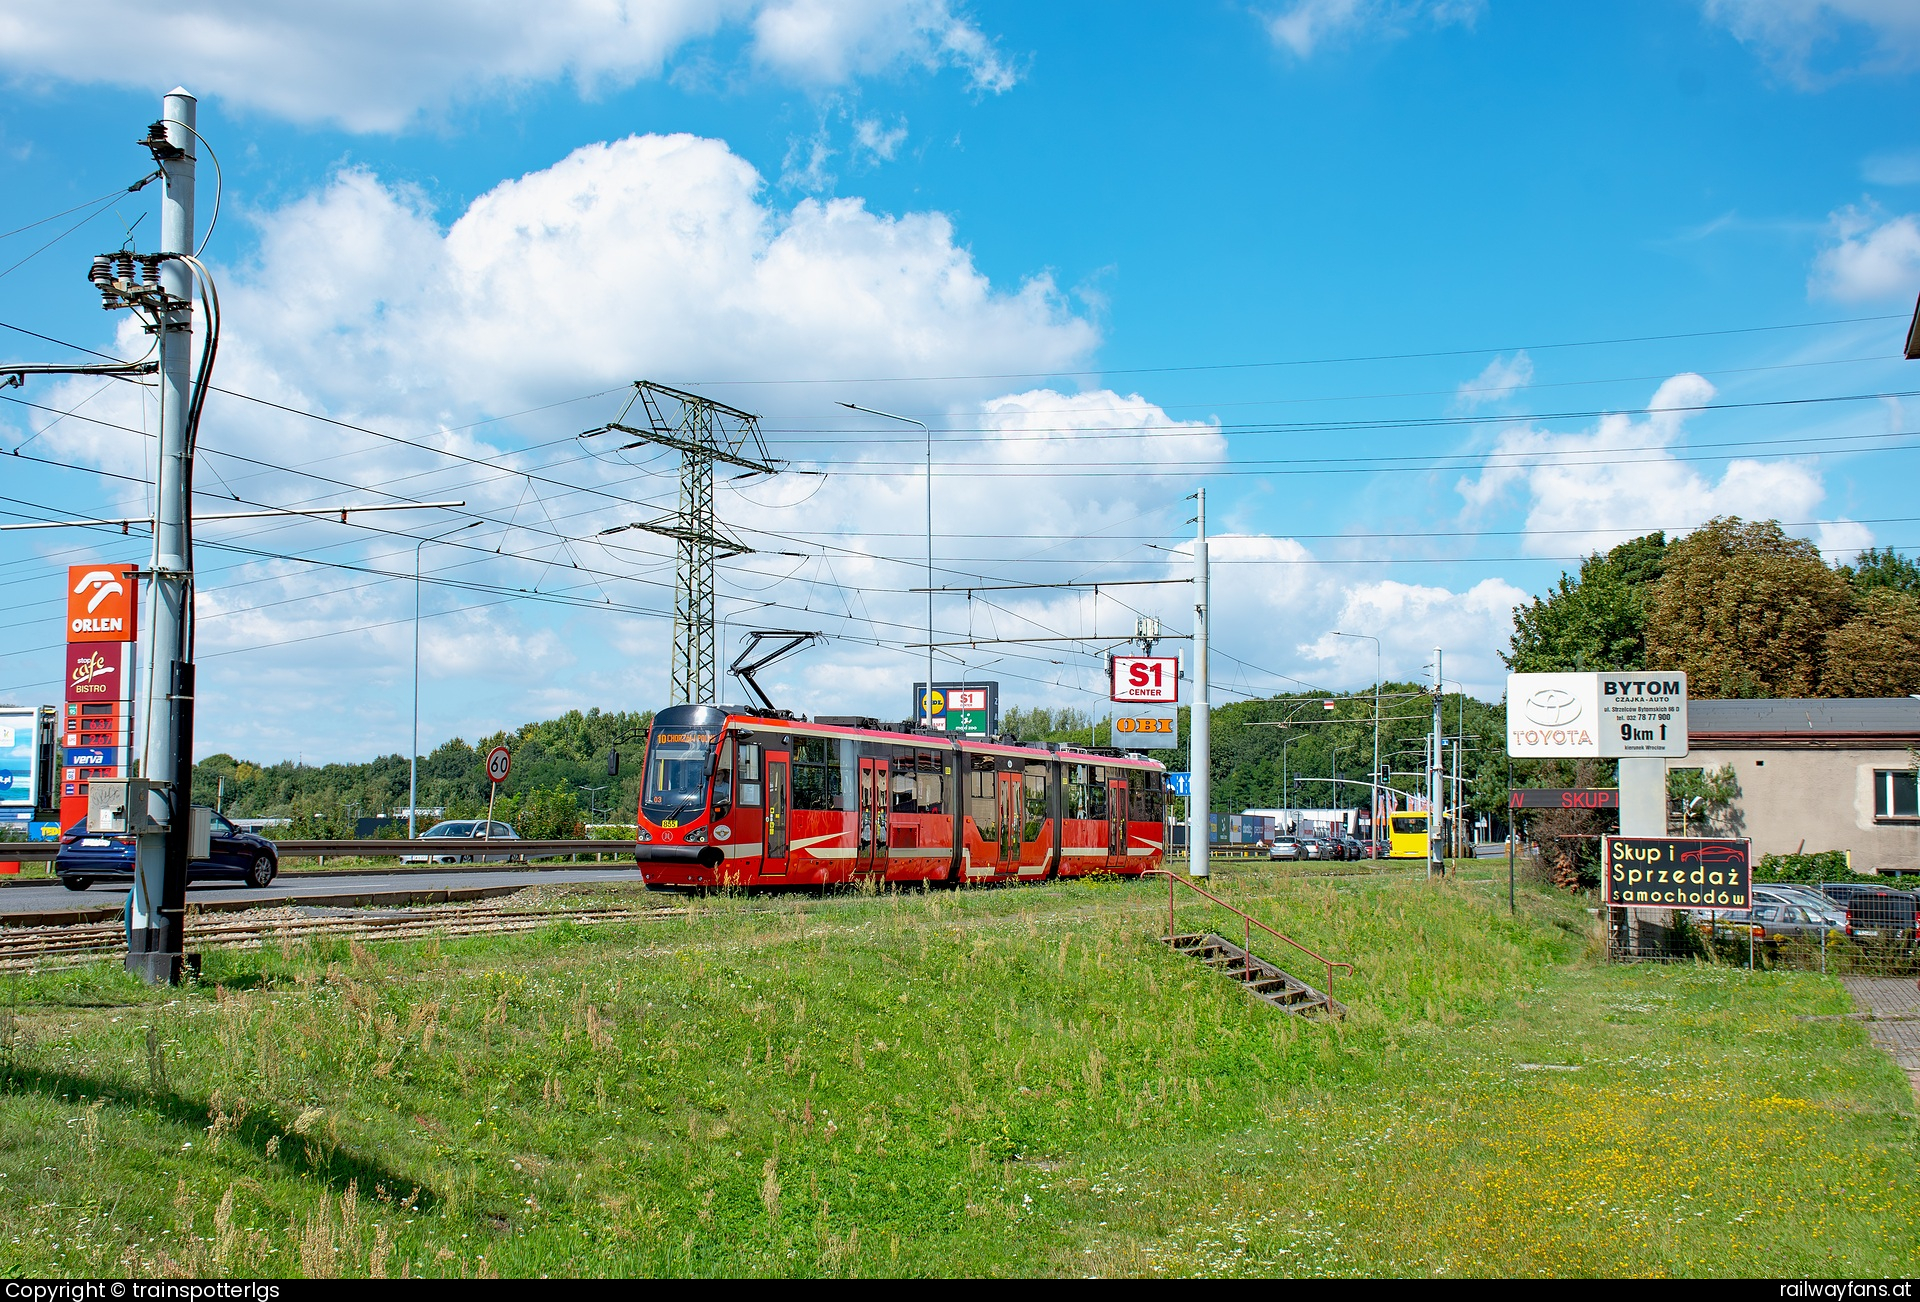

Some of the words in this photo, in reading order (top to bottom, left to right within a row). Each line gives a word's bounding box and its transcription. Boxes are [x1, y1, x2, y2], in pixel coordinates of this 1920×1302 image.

[72, 617, 123, 633] ORLEN
[72, 651, 105, 683] cafe
[1128, 662, 1162, 687] S1
[75, 684, 107, 693] BISTRO
[1129, 688, 1162, 696] CENTER
[1604, 681, 1680, 695] BYTOM
[960, 693, 973, 704] S1
[89, 719, 113, 729] 6.37
[1116, 717, 1173, 733] OBI
[1620, 723, 1632, 741] 9
[1633, 728, 1654, 740] km
[89, 734, 112, 745] 2.67
[657, 734, 667, 744] 10
[1513, 729, 1593, 745] TOYOTA
[73, 754, 104, 765] verva
[490, 756, 508, 773] 60
[1561, 792, 1610, 808] SKUP
[1612, 842, 1662, 864] Skup
[1669, 844, 1675, 862] i
[1612, 863, 1739, 886] Sprzedaż
[1612, 888, 1745, 905] samochodów
